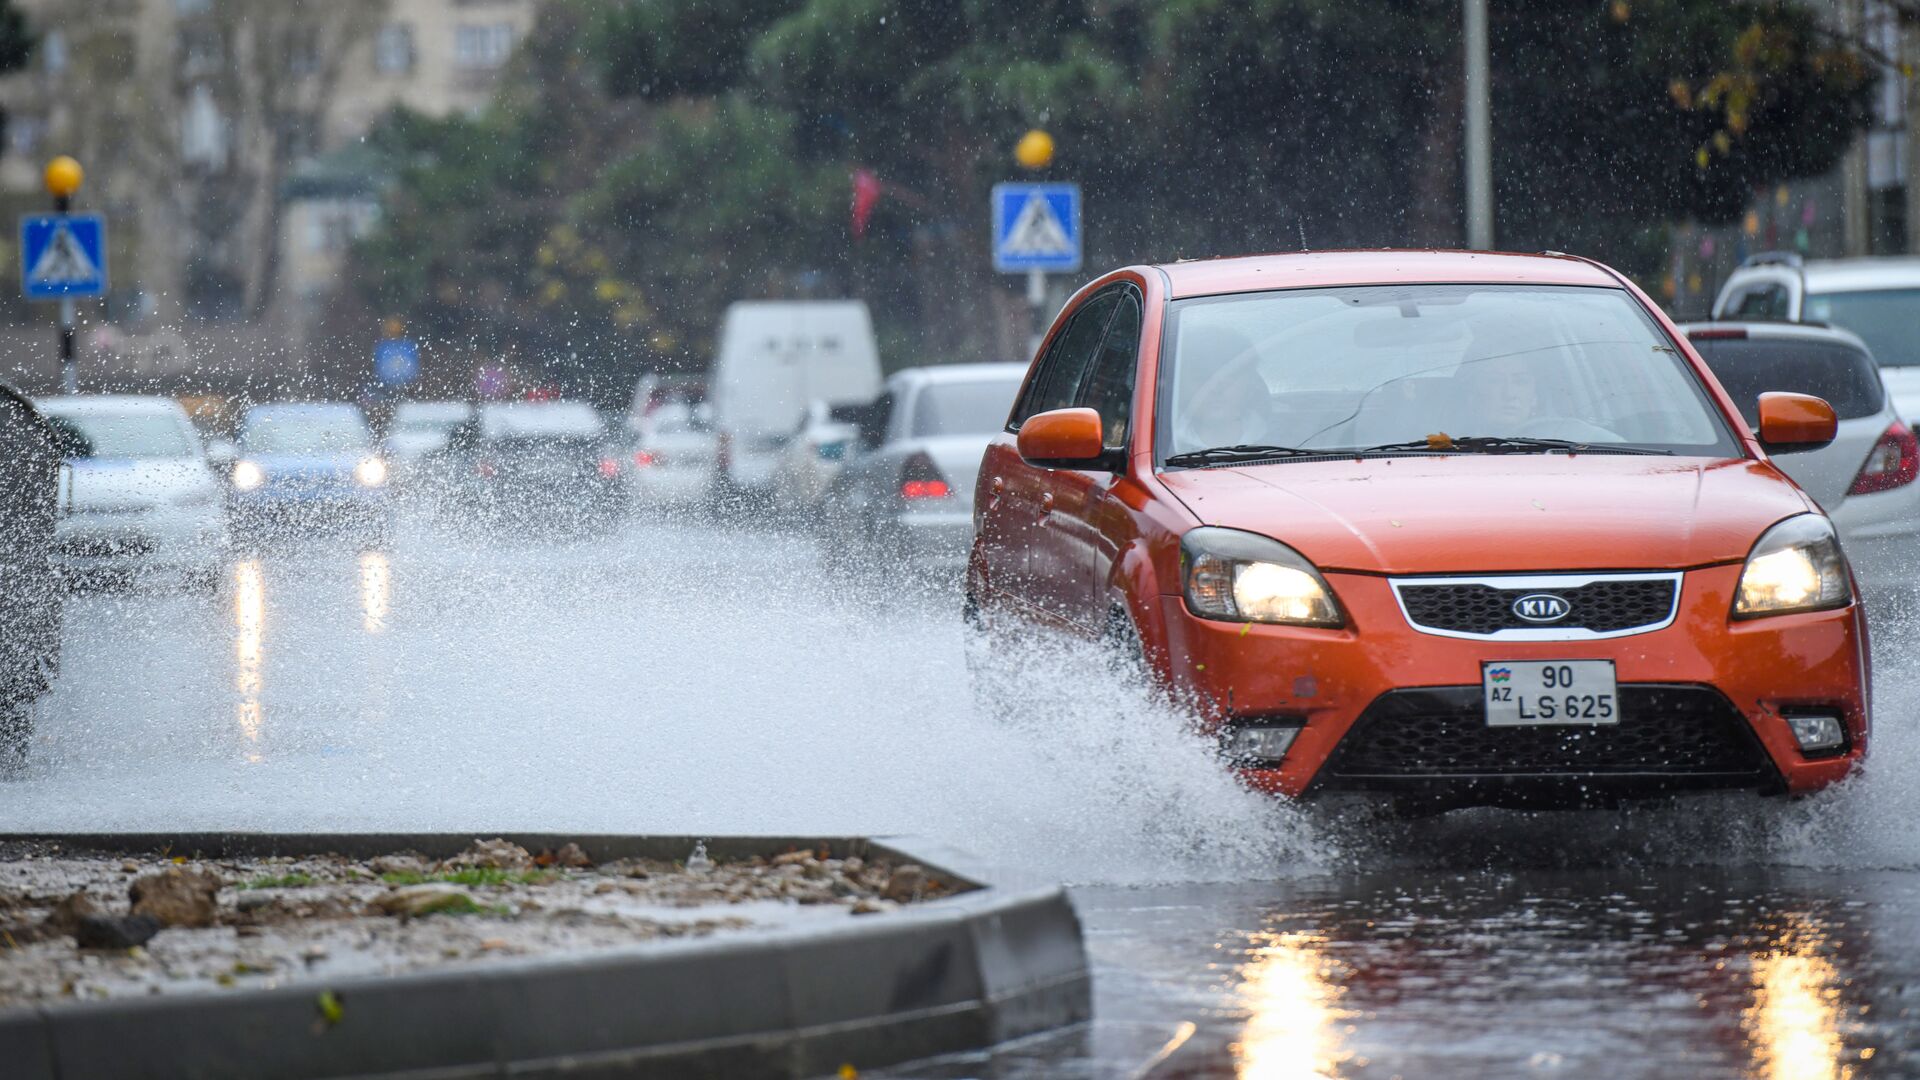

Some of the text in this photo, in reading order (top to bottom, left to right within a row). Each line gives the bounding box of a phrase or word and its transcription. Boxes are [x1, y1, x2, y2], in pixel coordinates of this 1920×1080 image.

[1522, 600, 1562, 616] KIA
[1542, 665, 1573, 688] 90
[1491, 687, 1512, 702] AZ
[1518, 695, 1613, 719] LS 625
